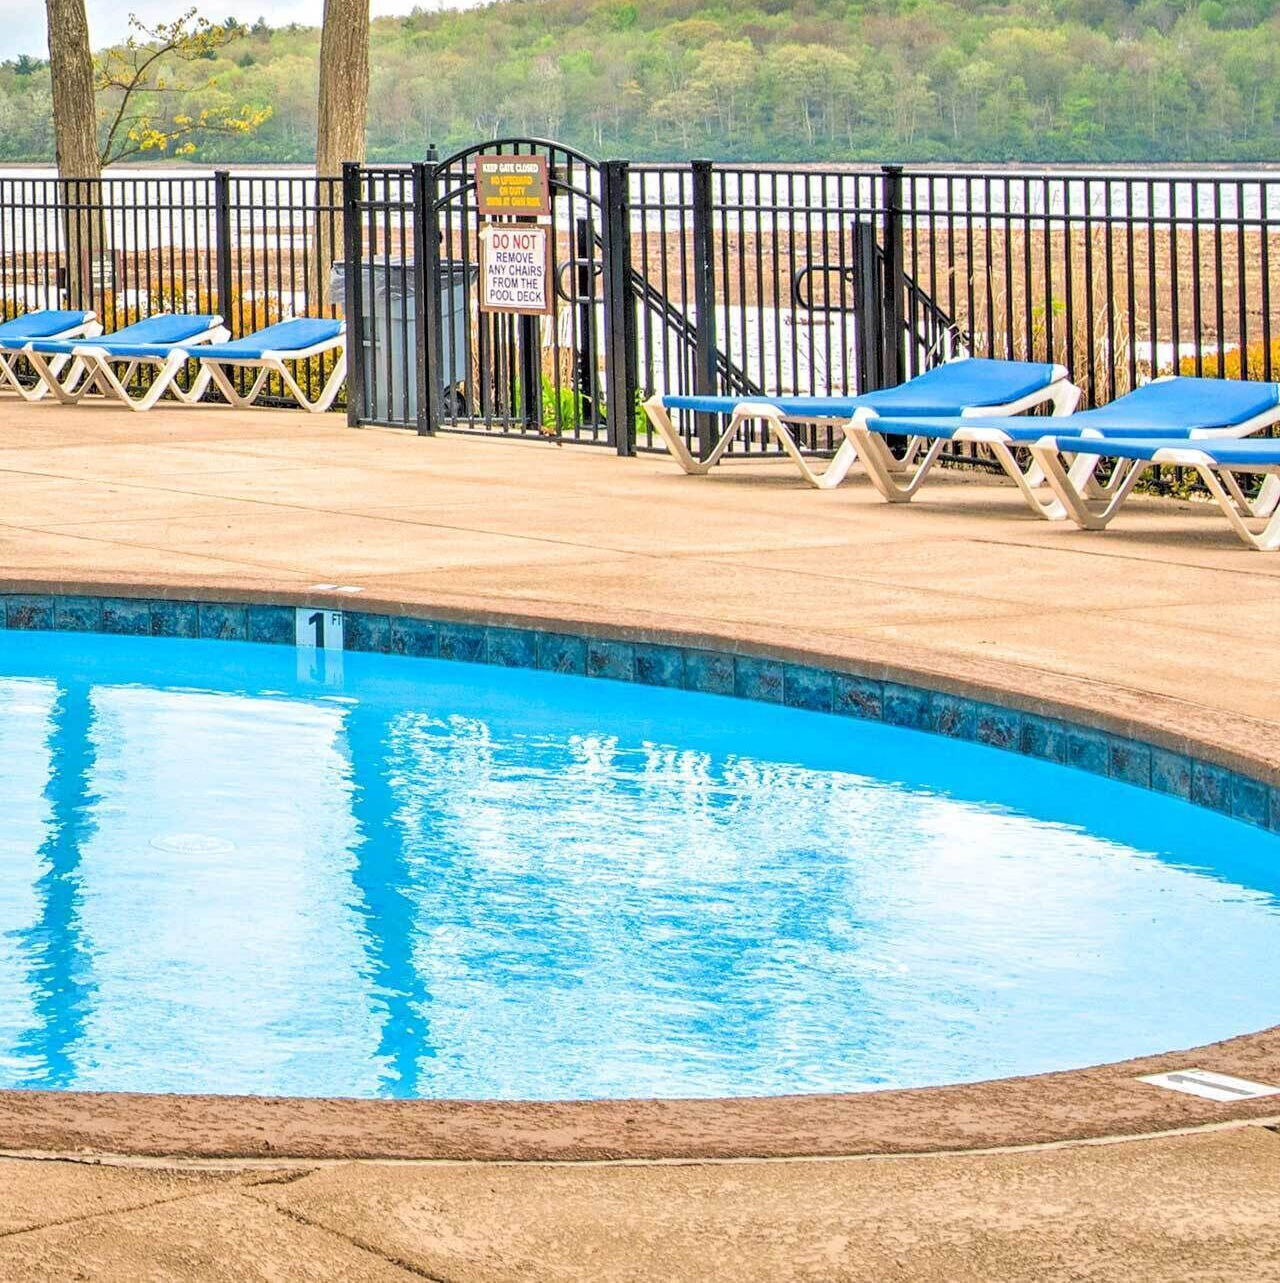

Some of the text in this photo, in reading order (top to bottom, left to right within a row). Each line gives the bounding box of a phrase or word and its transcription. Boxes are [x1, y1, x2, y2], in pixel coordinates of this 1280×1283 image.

[483, 163, 539, 173] KEEP GATE CLOSED
[491, 175, 500, 185] NO
[510, 186, 525, 196] DUTY
[493, 233, 537, 249] DO NOT
[496, 251, 534, 264] REMOVE
[489, 264, 543, 277] ANY CHAIRS
[492, 277, 538, 289] FROM THE
[490, 289, 542, 302] POOL DECK
[308, 612, 343, 648] 1 FT
